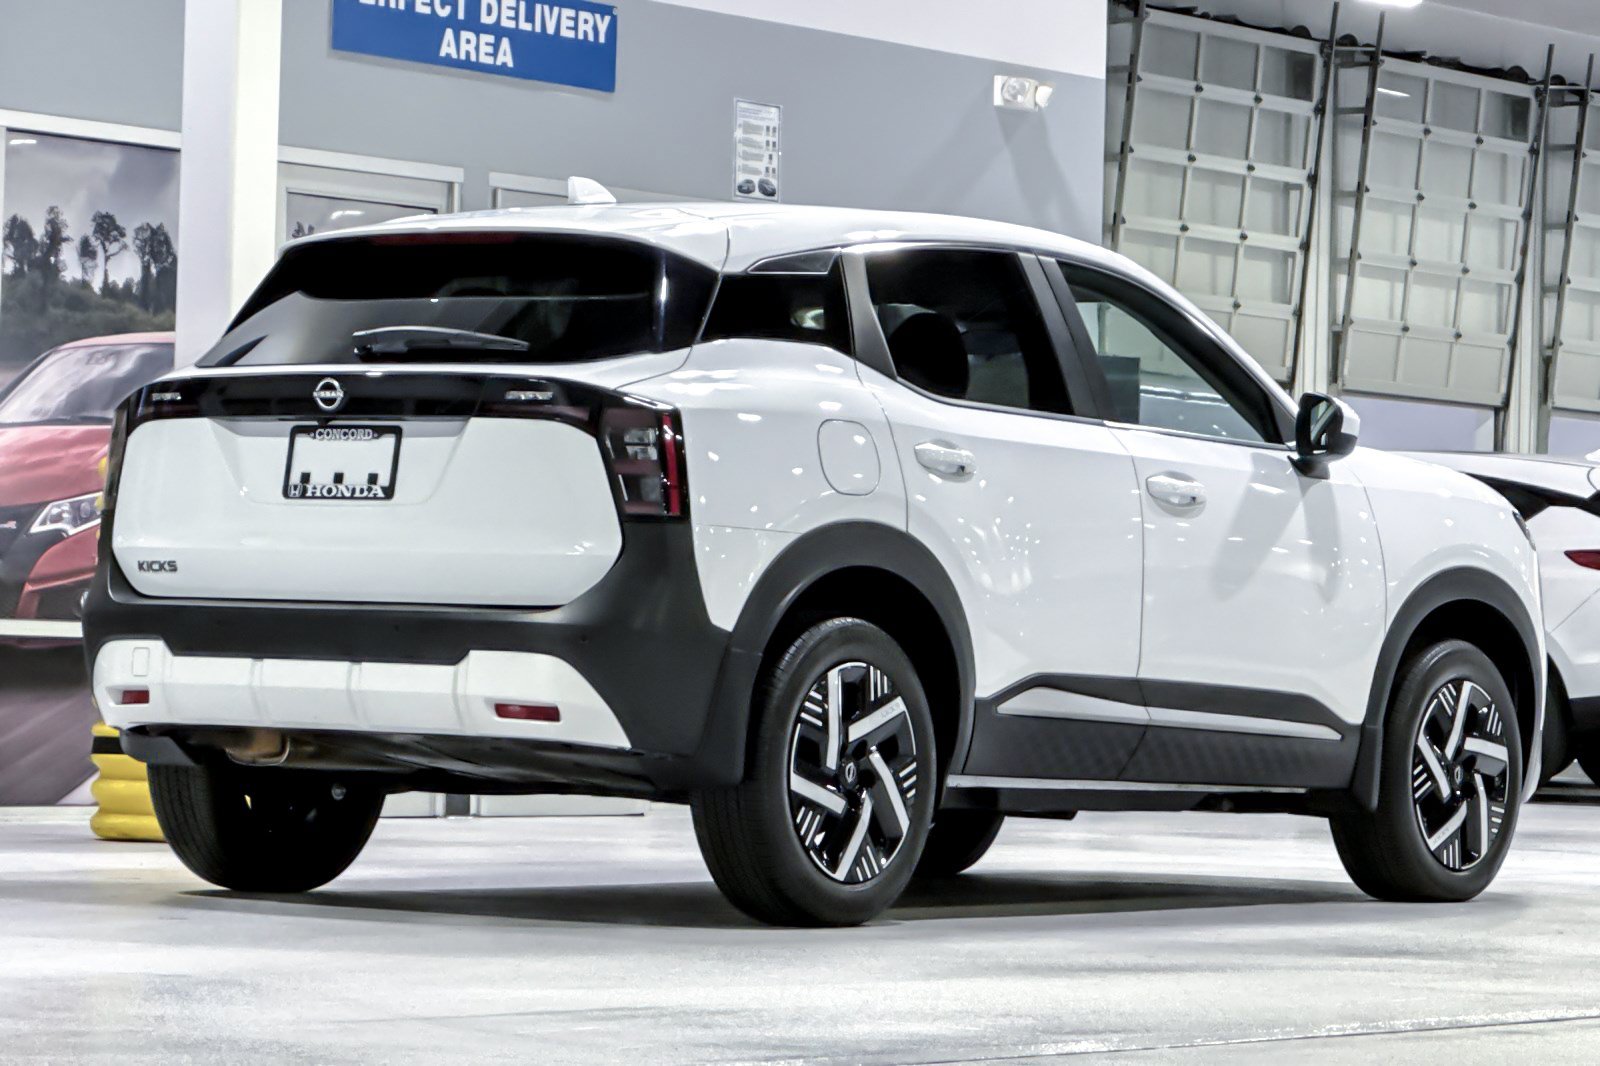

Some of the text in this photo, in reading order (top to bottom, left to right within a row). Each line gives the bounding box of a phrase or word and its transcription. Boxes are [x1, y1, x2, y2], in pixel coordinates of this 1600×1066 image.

[480, 0, 611, 44] DELIVERY
[439, 28, 514, 68] AREA
[315, 428, 373, 440] CONCORD
[305, 484, 385, 497] HONDA
[137, 560, 178, 572] KICKS
